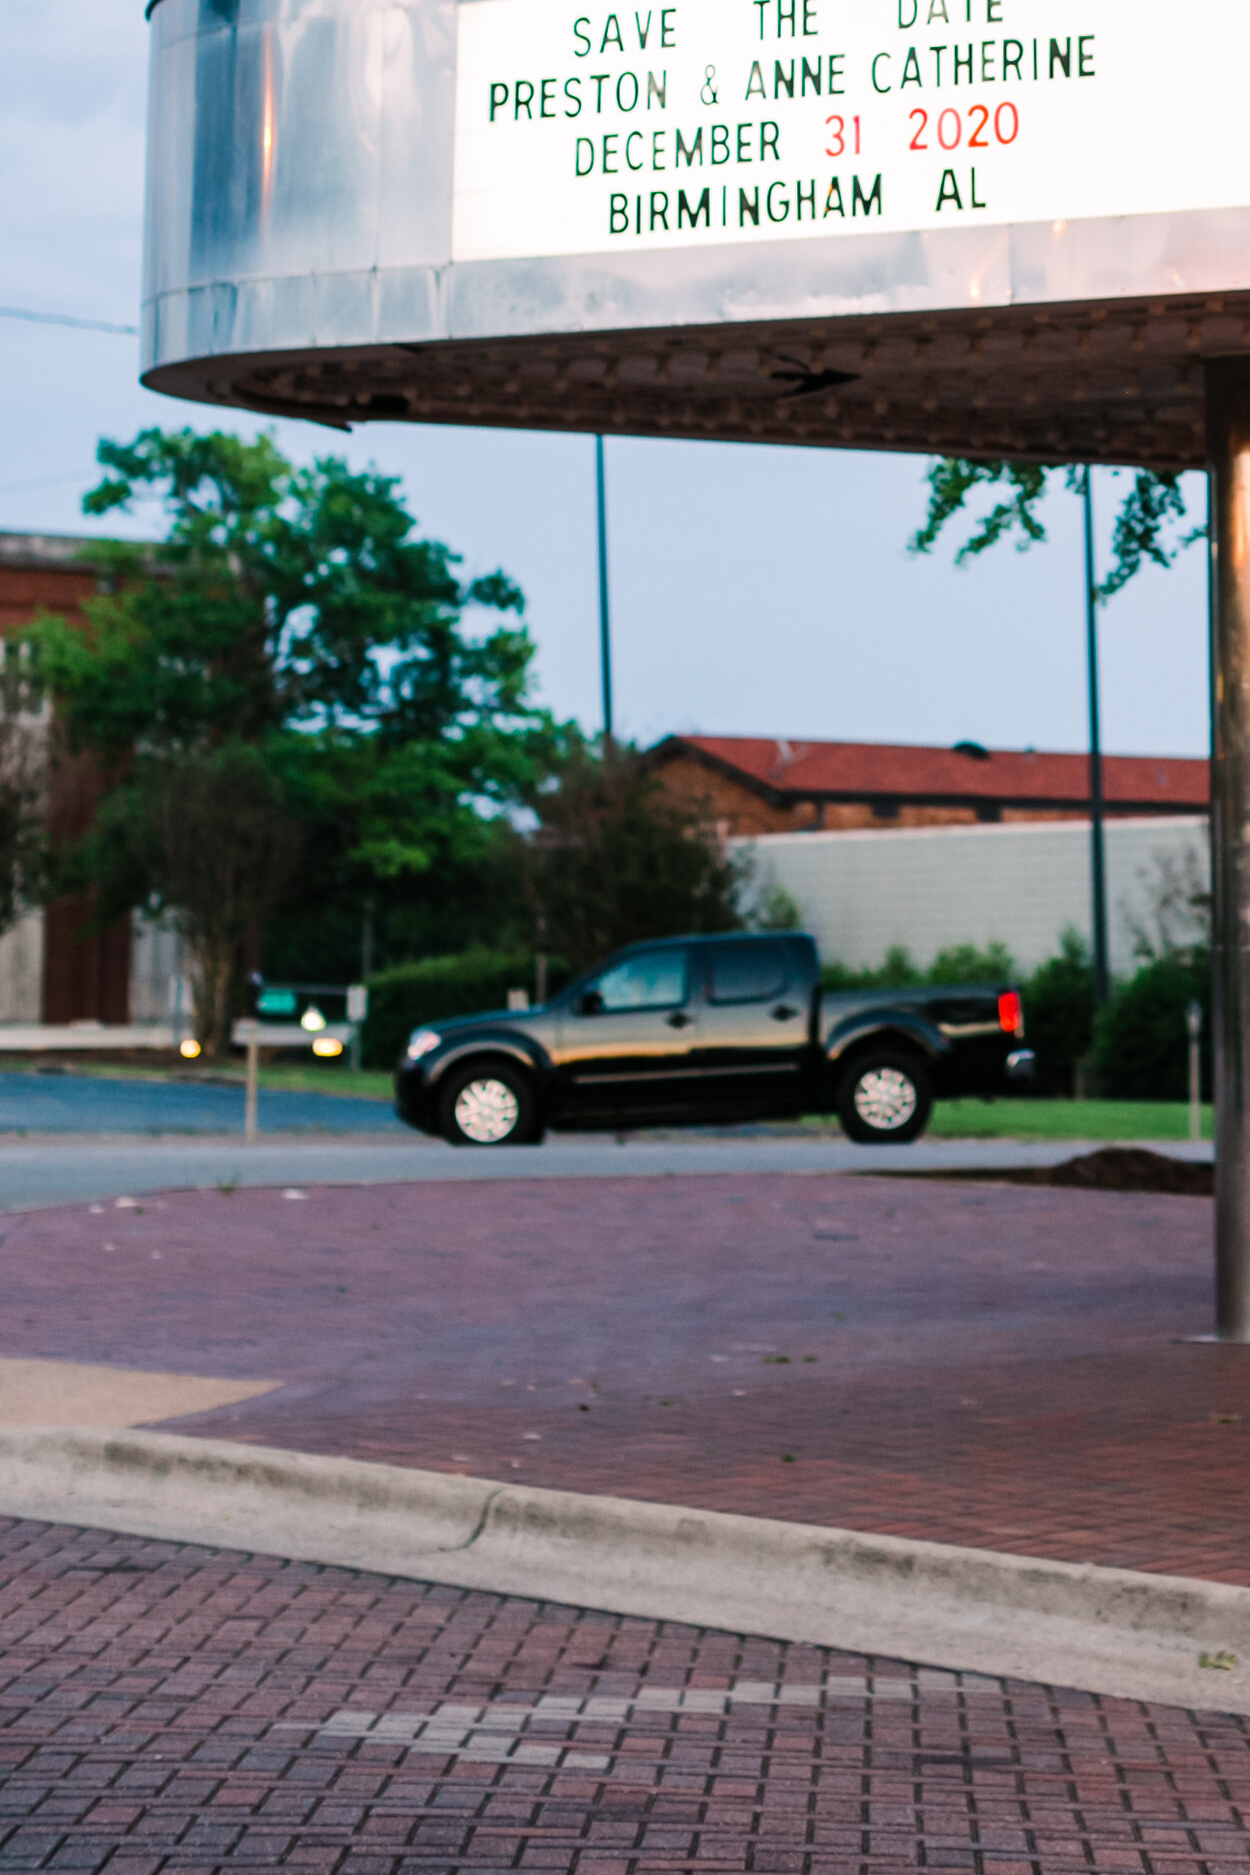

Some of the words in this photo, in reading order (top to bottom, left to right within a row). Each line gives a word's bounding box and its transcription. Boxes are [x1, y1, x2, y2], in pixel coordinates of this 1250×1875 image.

[573, 7, 677, 59] SAVE
[488, 69, 668, 123] PRESTON
[699, 63, 720, 106] &
[744, 53, 846, 102] ANNE
[870, 33, 1097, 95] CATHERINE
[575, 120, 781, 178] DECEMBER
[824, 114, 862, 158] 31
[908, 100, 1020, 152] 2020
[608, 172, 883, 235] BIRMINGHAM
[934, 166, 988, 213] AL
